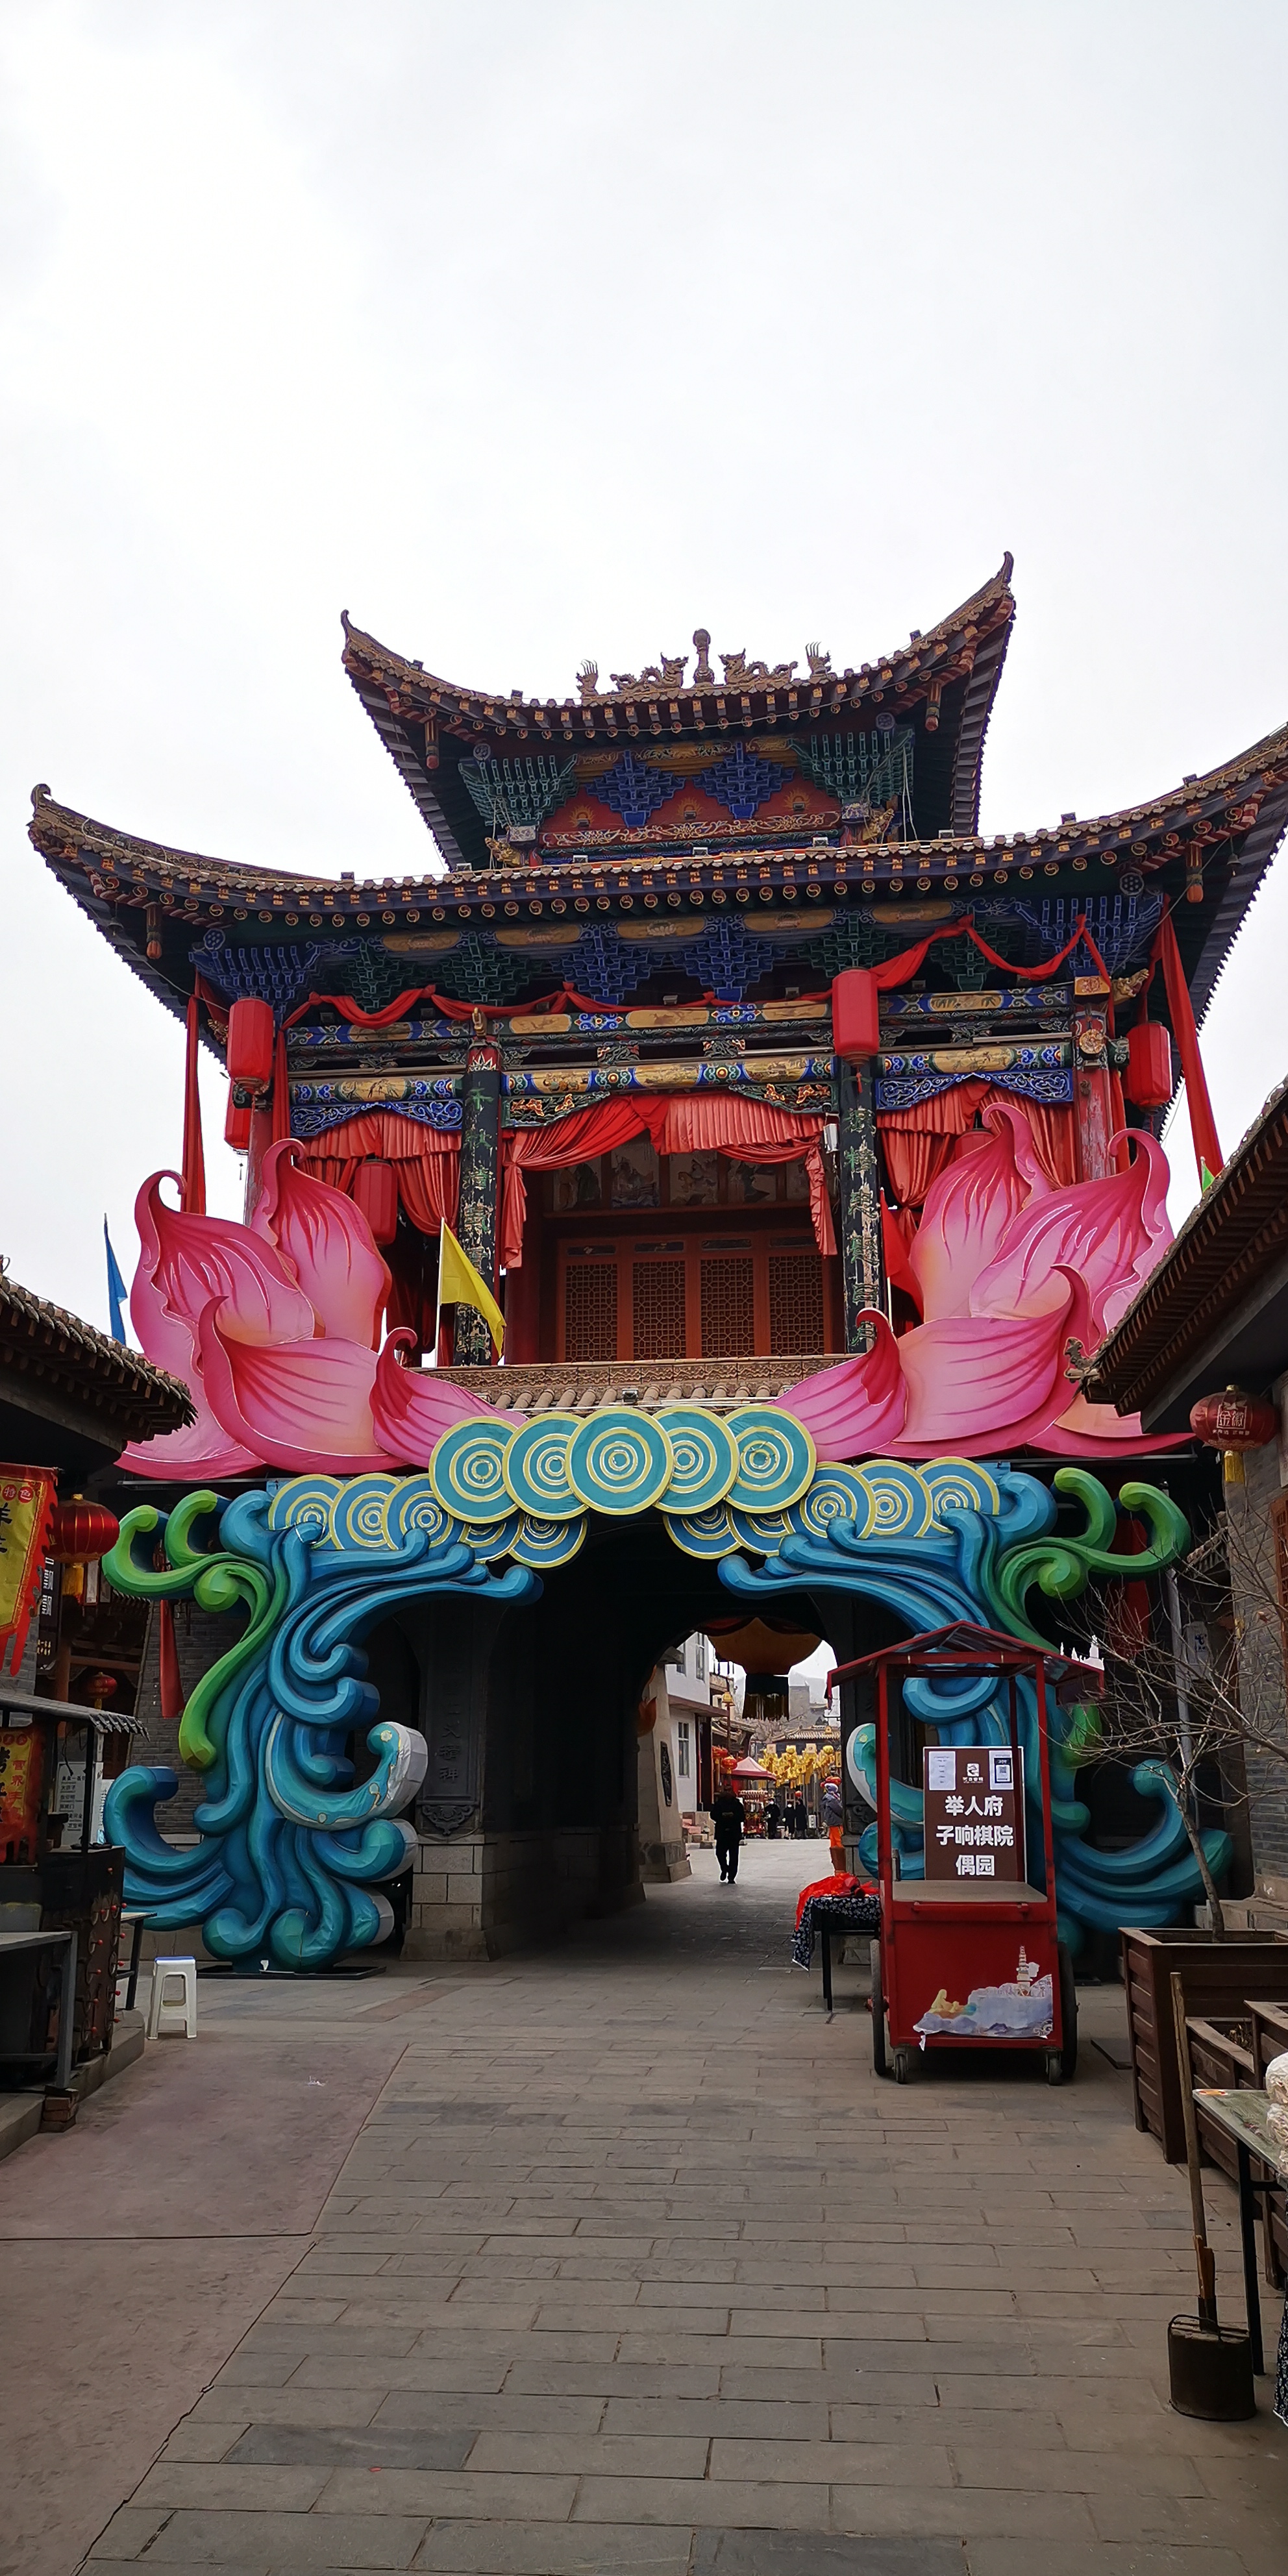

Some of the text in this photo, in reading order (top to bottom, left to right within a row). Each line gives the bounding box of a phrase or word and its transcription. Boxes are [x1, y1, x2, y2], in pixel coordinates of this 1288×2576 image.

[945, 1795, 1003, 1816] 举人府
[935, 1825, 1014, 1846] 子响棋院
[956, 1855, 995, 1876] 偶园
